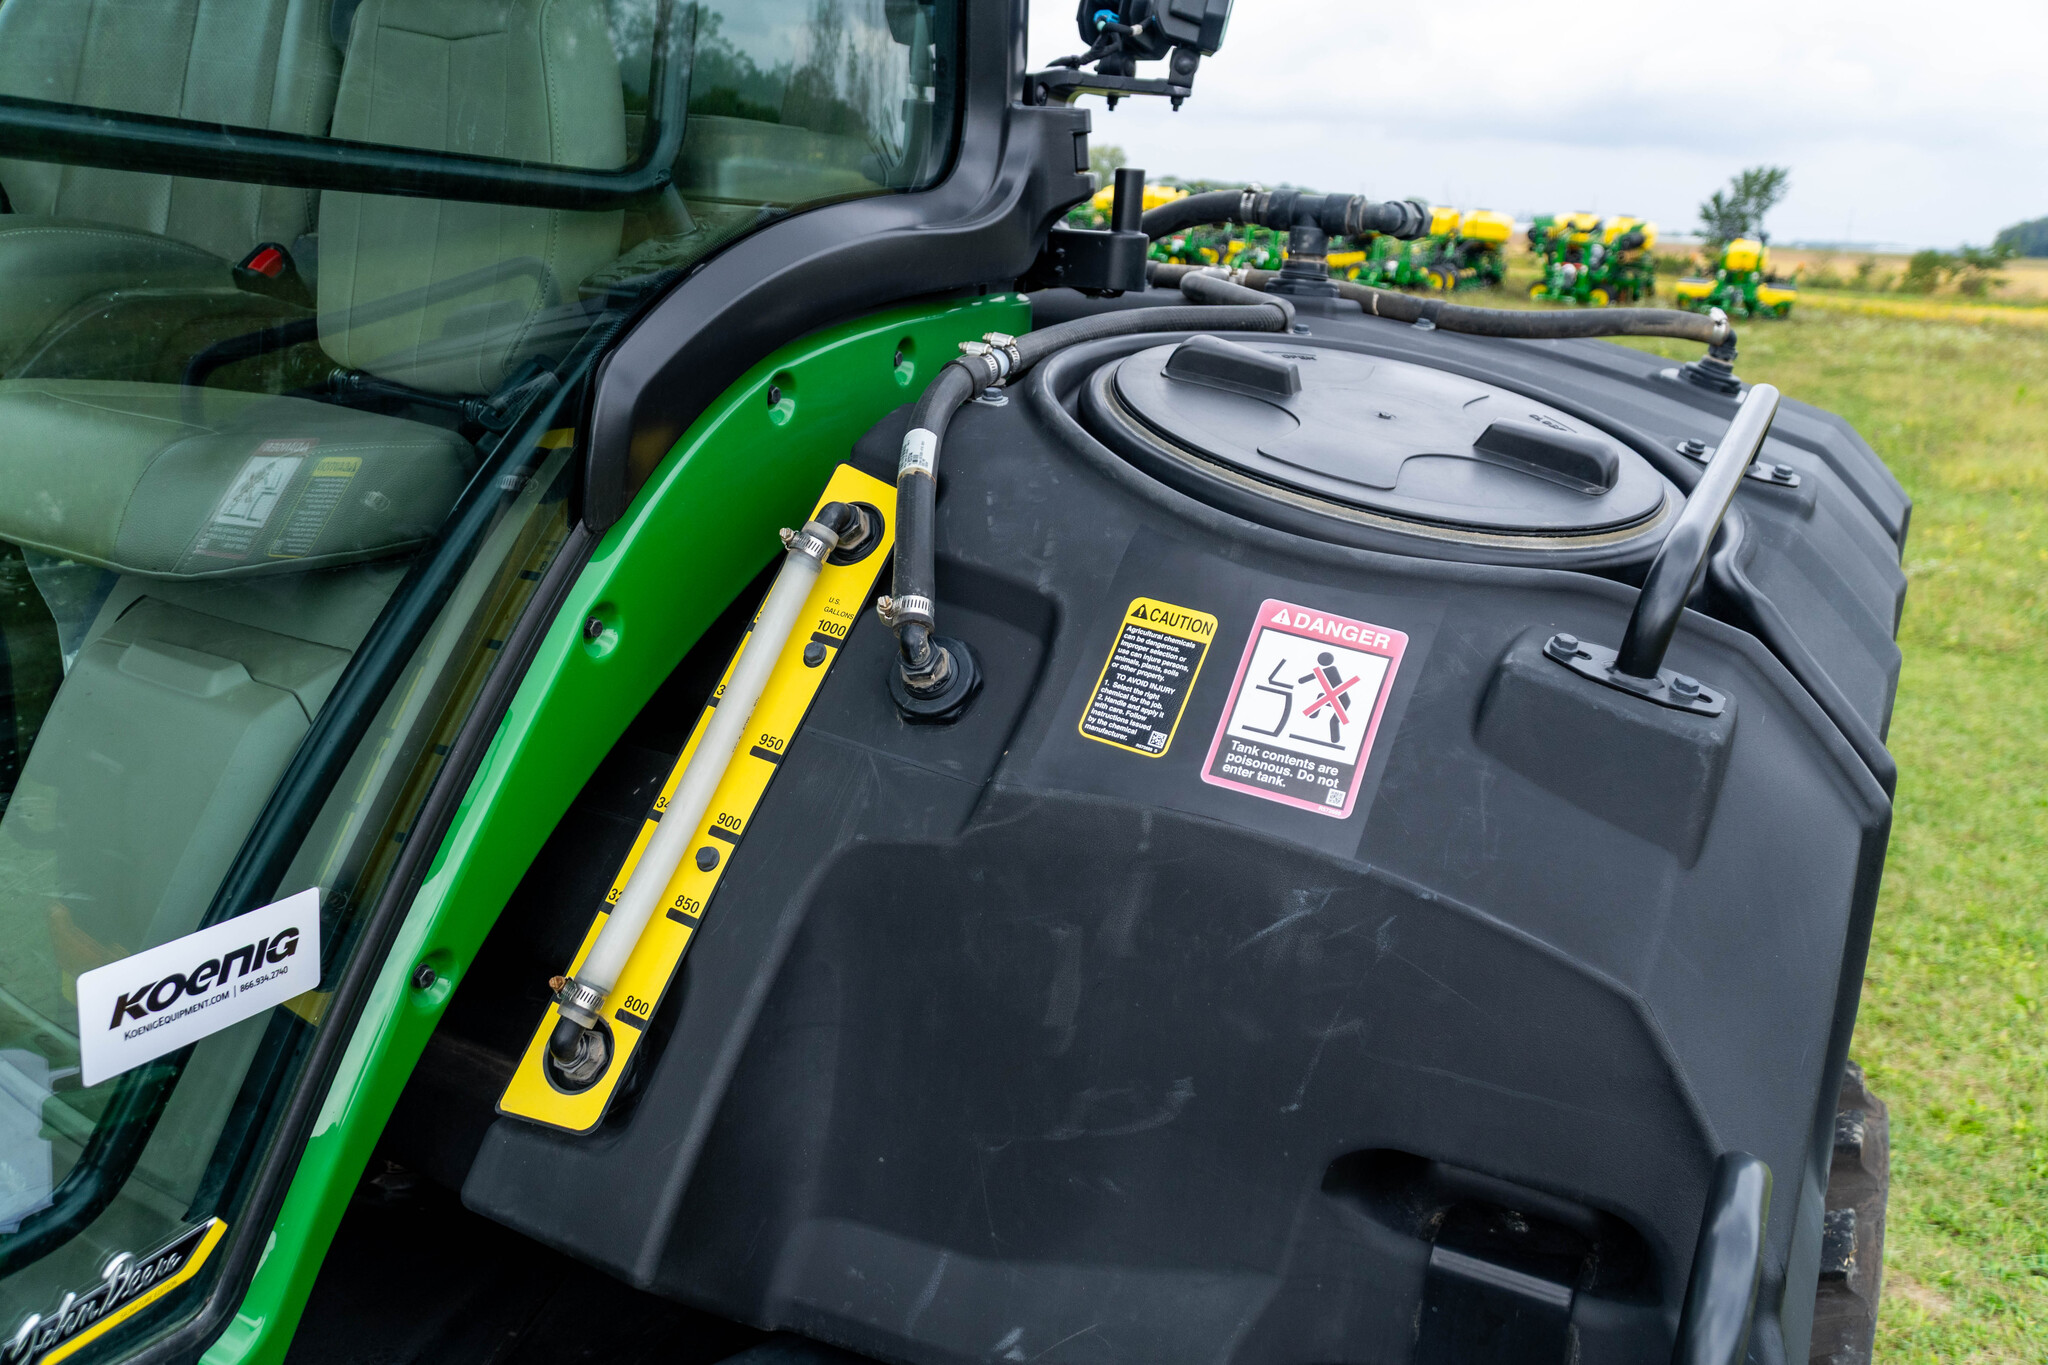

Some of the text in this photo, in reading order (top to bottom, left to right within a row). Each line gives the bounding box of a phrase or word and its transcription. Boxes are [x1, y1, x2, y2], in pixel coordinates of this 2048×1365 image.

[828, 597, 840, 605] U.S.
[824, 606, 854, 620] GALLONS
[1150, 608, 1214, 636] CAUTION
[818, 619, 847, 637] 1000
[1123, 633, 1136, 641] can
[1136, 635, 1145, 643] be
[1126, 626, 1196, 649] Agricultural chemicals
[1293, 612, 1391, 650] DANGER
[1117, 647, 1130, 655] use
[1130, 651, 1143, 659] can
[1120, 639, 1150, 652] Improper
[1149, 648, 1179, 661] selection
[1119, 664, 1137, 673] other
[1163, 668, 1179, 677] soils
[1112, 681, 1133, 693] Select
[1132, 687, 1144, 696] the
[1144, 691, 1160, 701] right
[1116, 672, 1176, 695] TO AVOID INJURY
[1100, 687, 1130, 700] chemical
[1129, 694, 1140, 703] for
[1139, 698, 1151, 706] the
[1104, 695, 1127, 707] Handle
[1127, 703, 1141, 711] and
[1140, 707, 1159, 718] apply
[1094, 701, 1109, 710] with
[1125, 709, 1148, 721] Follow
[1087, 715, 1138, 735] by the chemical
[758, 733, 784, 751] 950
[1232, 740, 1339, 776] Tank contents are
[1222, 764, 1286, 787] enter tank.
[1225, 753, 1339, 789] poisonous. Do not
[716, 812, 742, 830] 900
[675, 895, 700, 913] 850
[240, 966, 289, 993] 866.934.2740
[623, 995, 649, 1015] 800
[9, 1251, 182, 1365] John Deere
